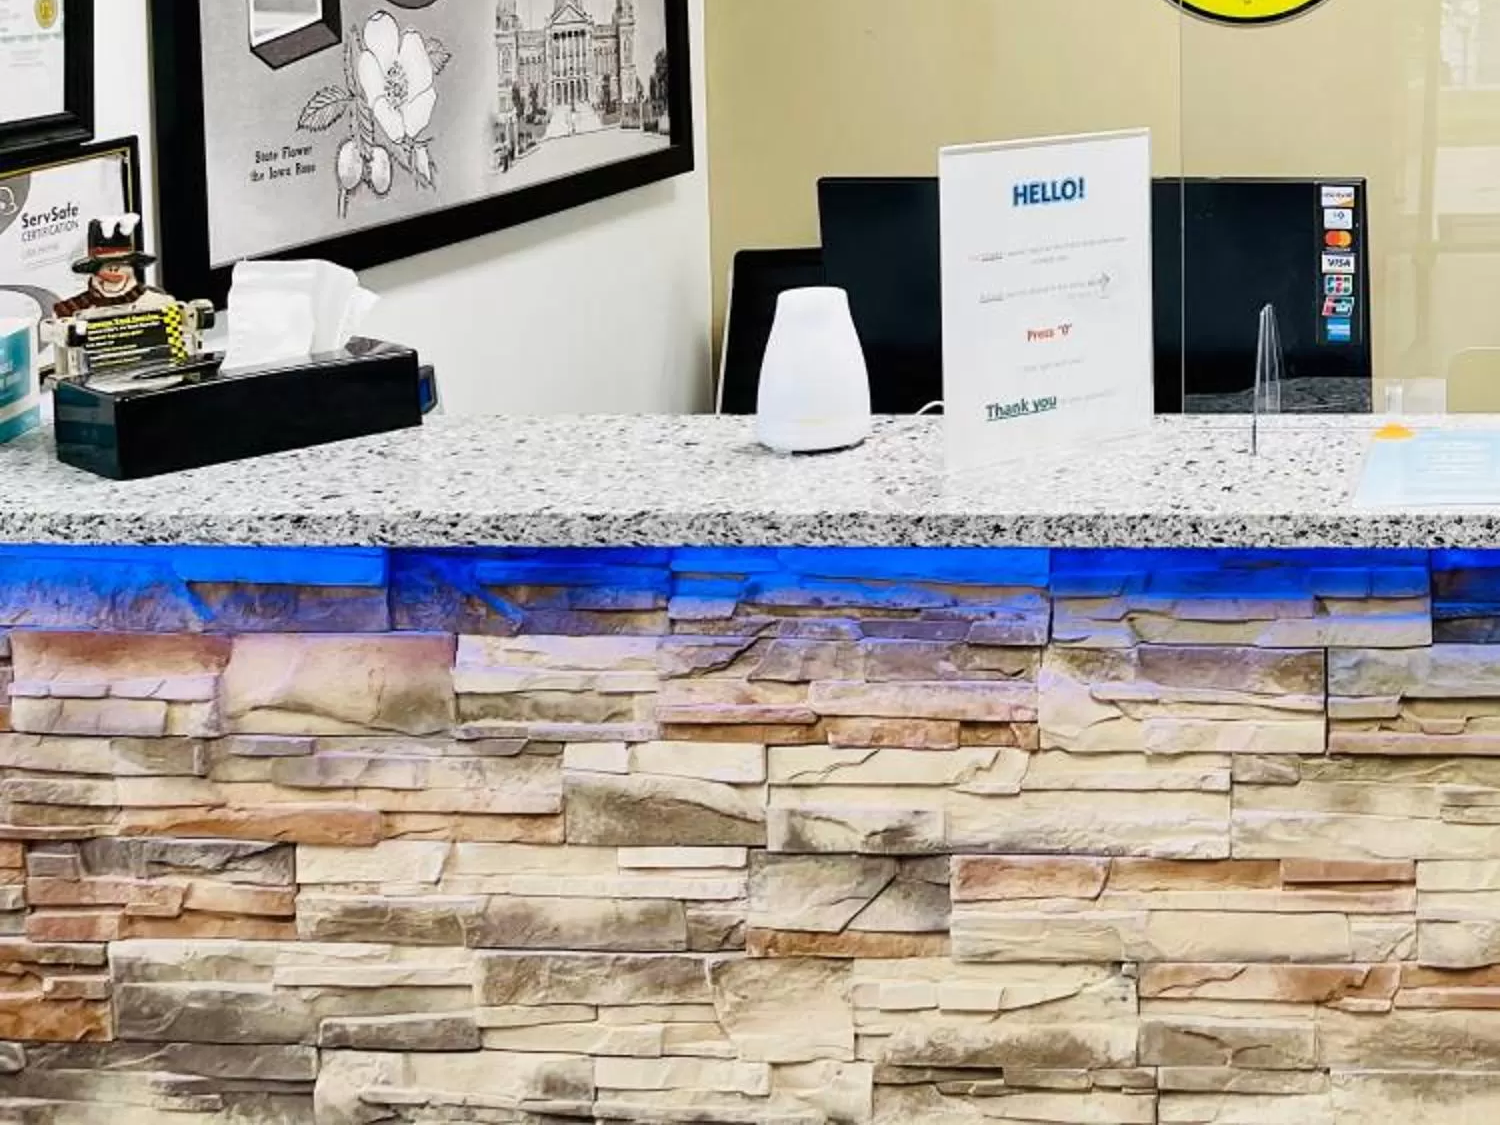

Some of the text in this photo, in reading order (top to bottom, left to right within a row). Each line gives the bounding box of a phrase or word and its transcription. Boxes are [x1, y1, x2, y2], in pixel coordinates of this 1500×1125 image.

[1012, 175, 1085, 207] HELLO!
[21, 202, 79, 229] ServSafe
[21, 220, 79, 242] CERTIFICATION
[1327, 257, 1351, 269] VISA
[1026, 327, 1054, 342] Press
[985, 397, 1031, 421] Thank
[1031, 395, 1058, 413] you
